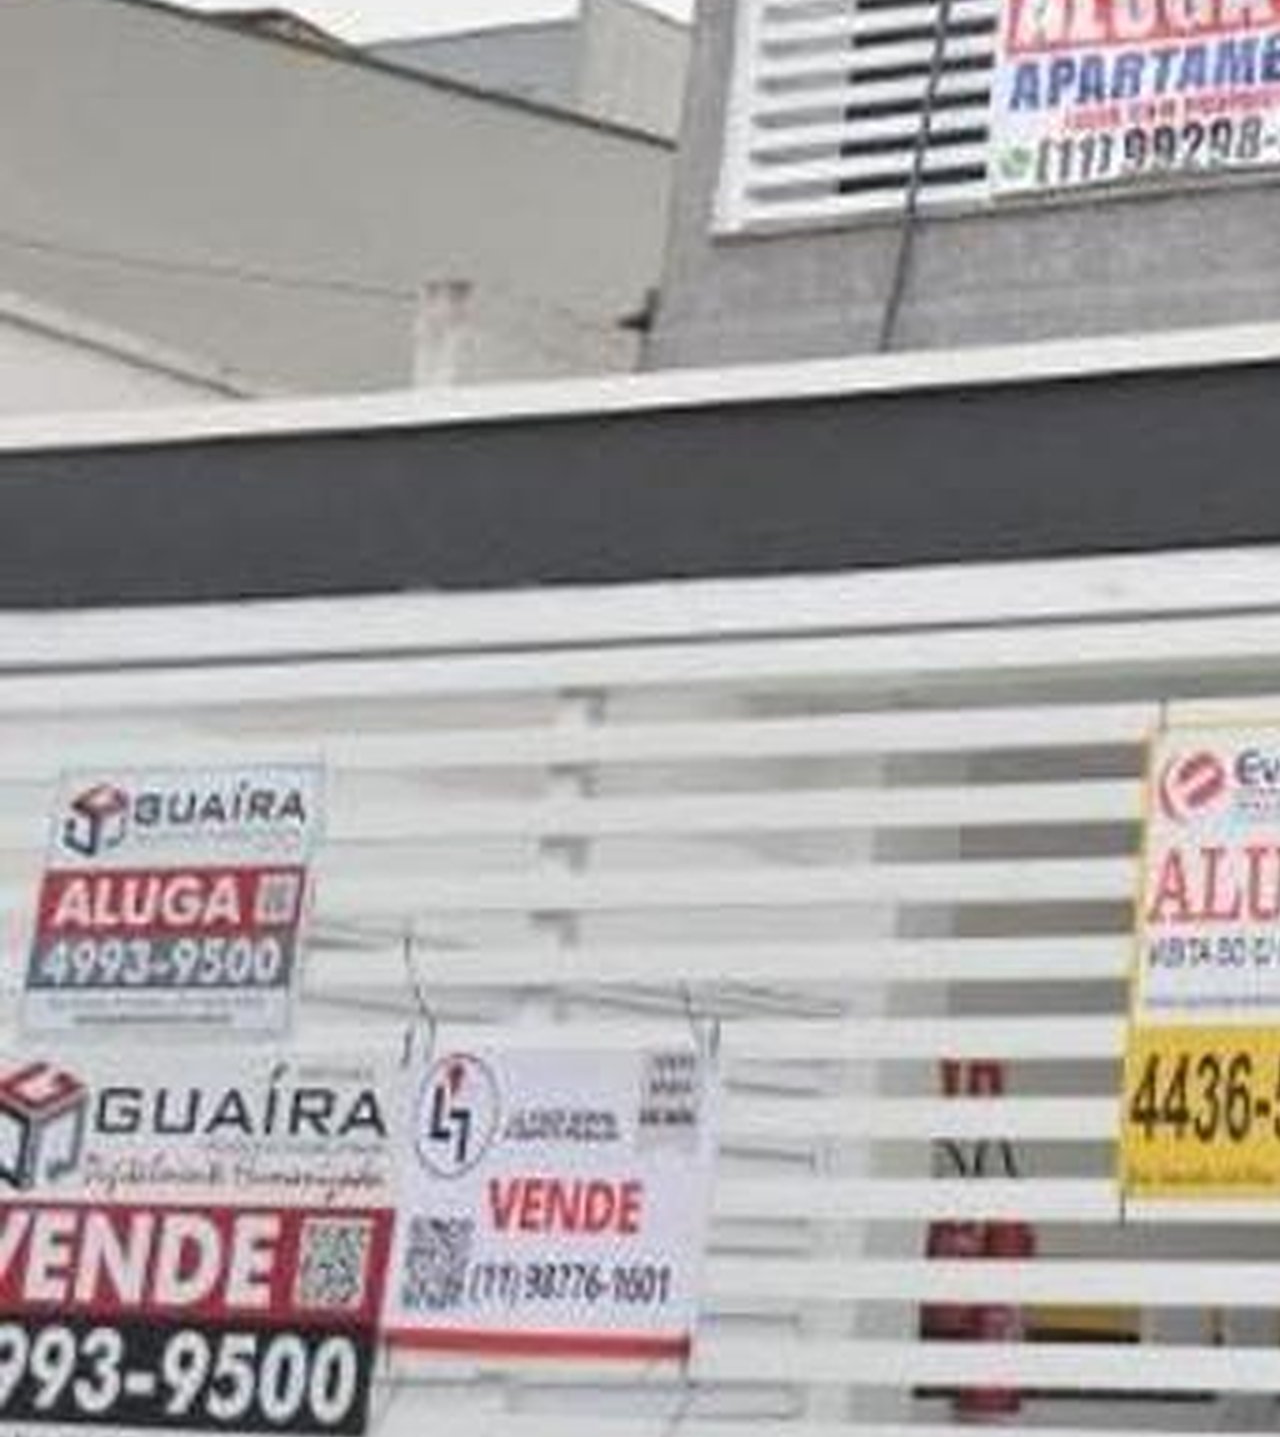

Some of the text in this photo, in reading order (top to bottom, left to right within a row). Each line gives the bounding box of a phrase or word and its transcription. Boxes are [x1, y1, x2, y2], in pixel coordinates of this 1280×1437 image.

[1037, 132, 1112, 181] (11)
[133, 780, 306, 826] GUAÍRA
[53, 876, 241, 926] ALUGA
[42, 935, 281, 985] 4993-9500
[93, 1062, 390, 1138] GUAÍRA
[488, 1178, 645, 1234] VENDE
